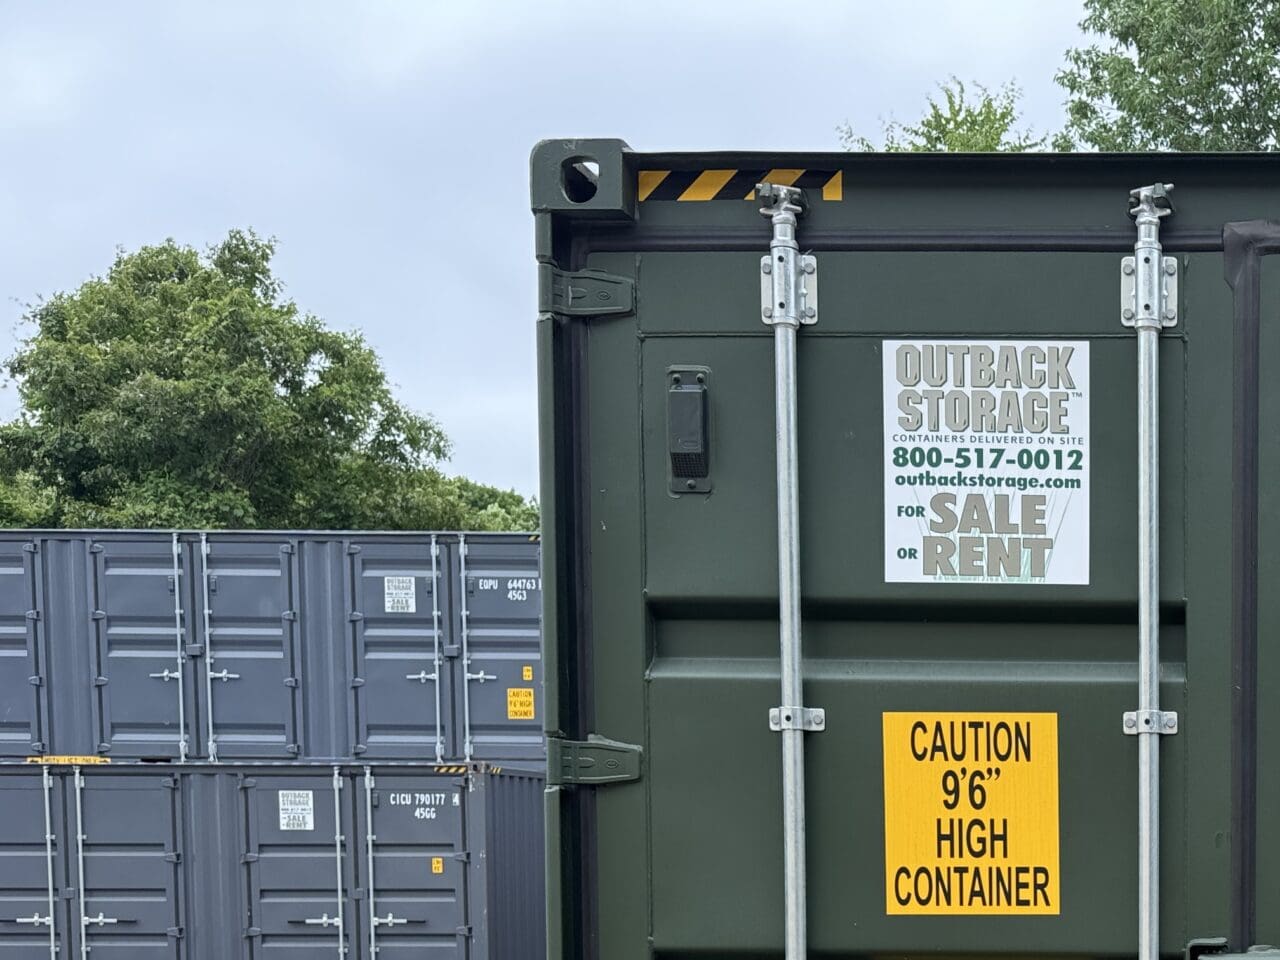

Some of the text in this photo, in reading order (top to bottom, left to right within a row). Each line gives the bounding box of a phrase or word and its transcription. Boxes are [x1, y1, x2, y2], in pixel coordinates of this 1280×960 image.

[896, 344, 1076, 389] OUTBACK
[897, 389, 1069, 434] STORAGE
[892, 434, 1084, 446] CONTAINERS DELIVERED ON SITE
[892, 447, 1084, 471] 800-517-0012
[894, 470, 1082, 491] outbackstorage.com
[897, 492, 1047, 534] FOR SALE
[896, 535, 1054, 578] OR RENT
[507, 579, 537, 590] 644763
[910, 720, 1031, 762] CAUTION
[414, 793, 446, 806] 790177
[936, 818, 1008, 859] HIGH
[894, 866, 1051, 907] CONTAINER
